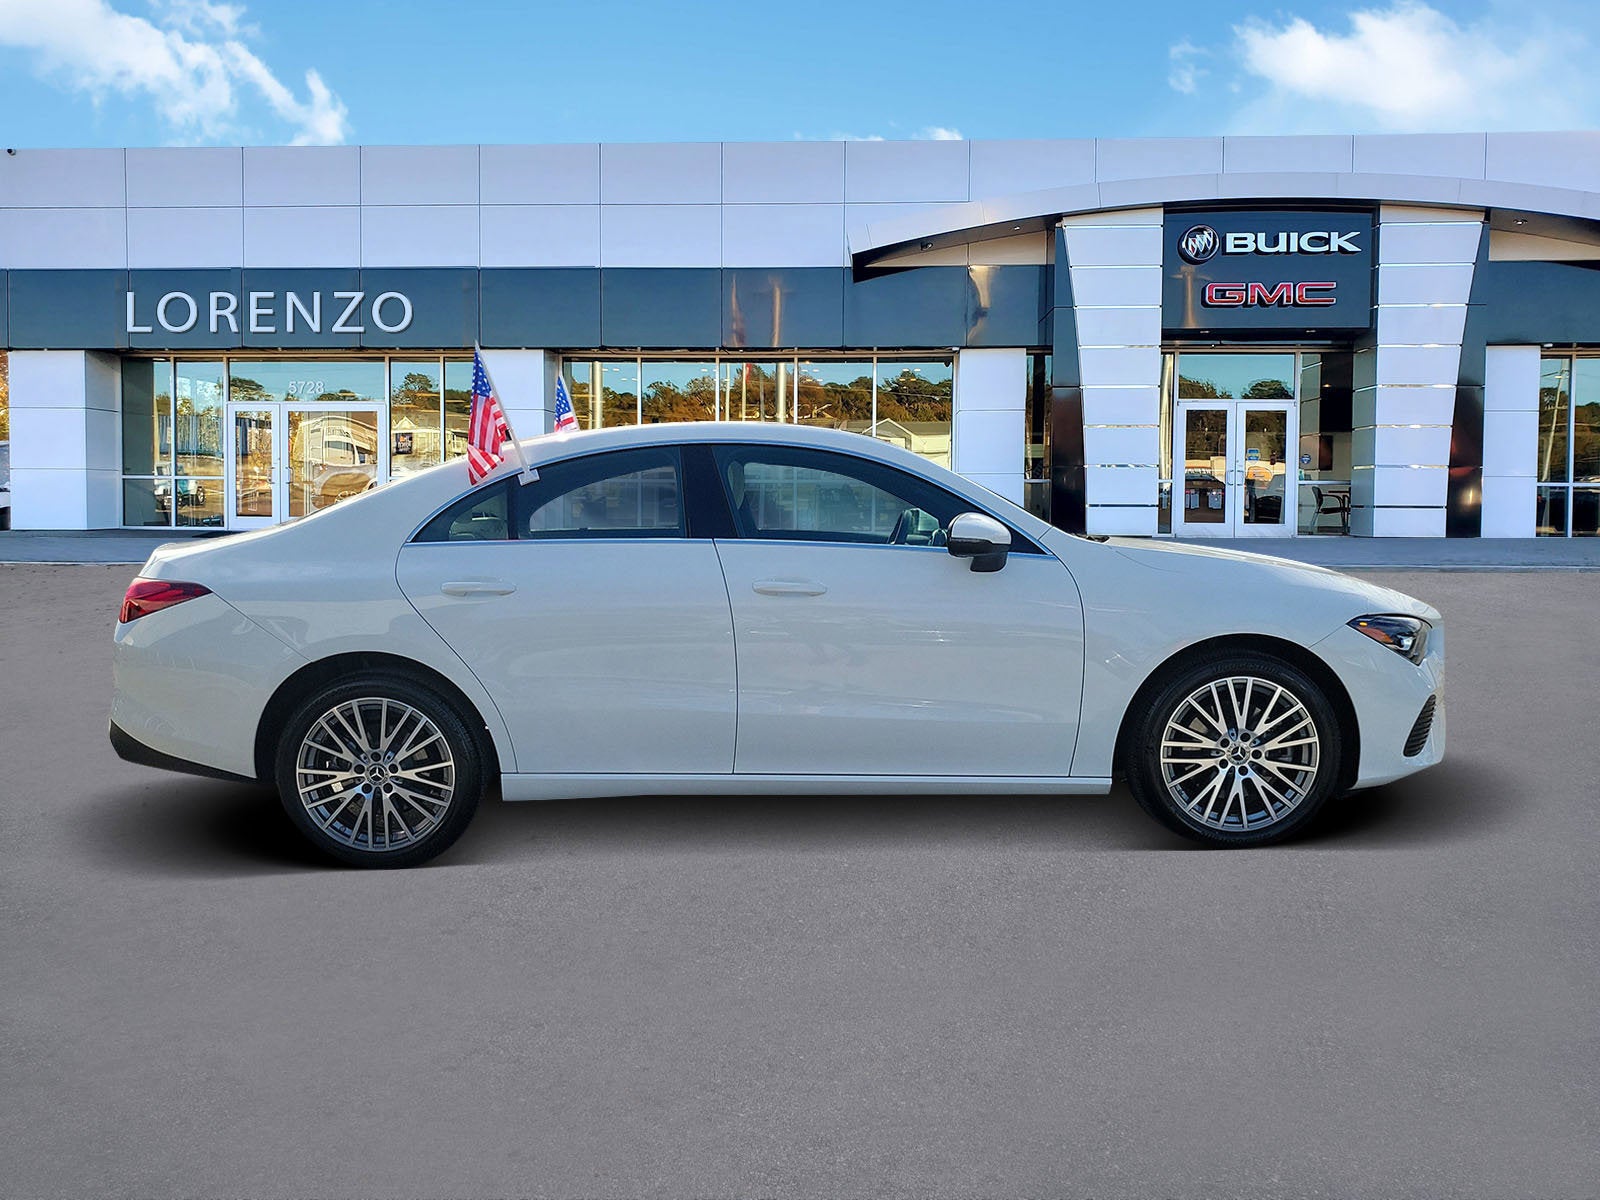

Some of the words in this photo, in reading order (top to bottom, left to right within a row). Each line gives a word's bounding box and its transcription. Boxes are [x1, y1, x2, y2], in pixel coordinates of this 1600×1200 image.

[1225, 231, 1362, 253] BUICK
[1205, 281, 1337, 305] GMC
[126, 291, 414, 333] LORENZO
[288, 381, 325, 394] 5728
